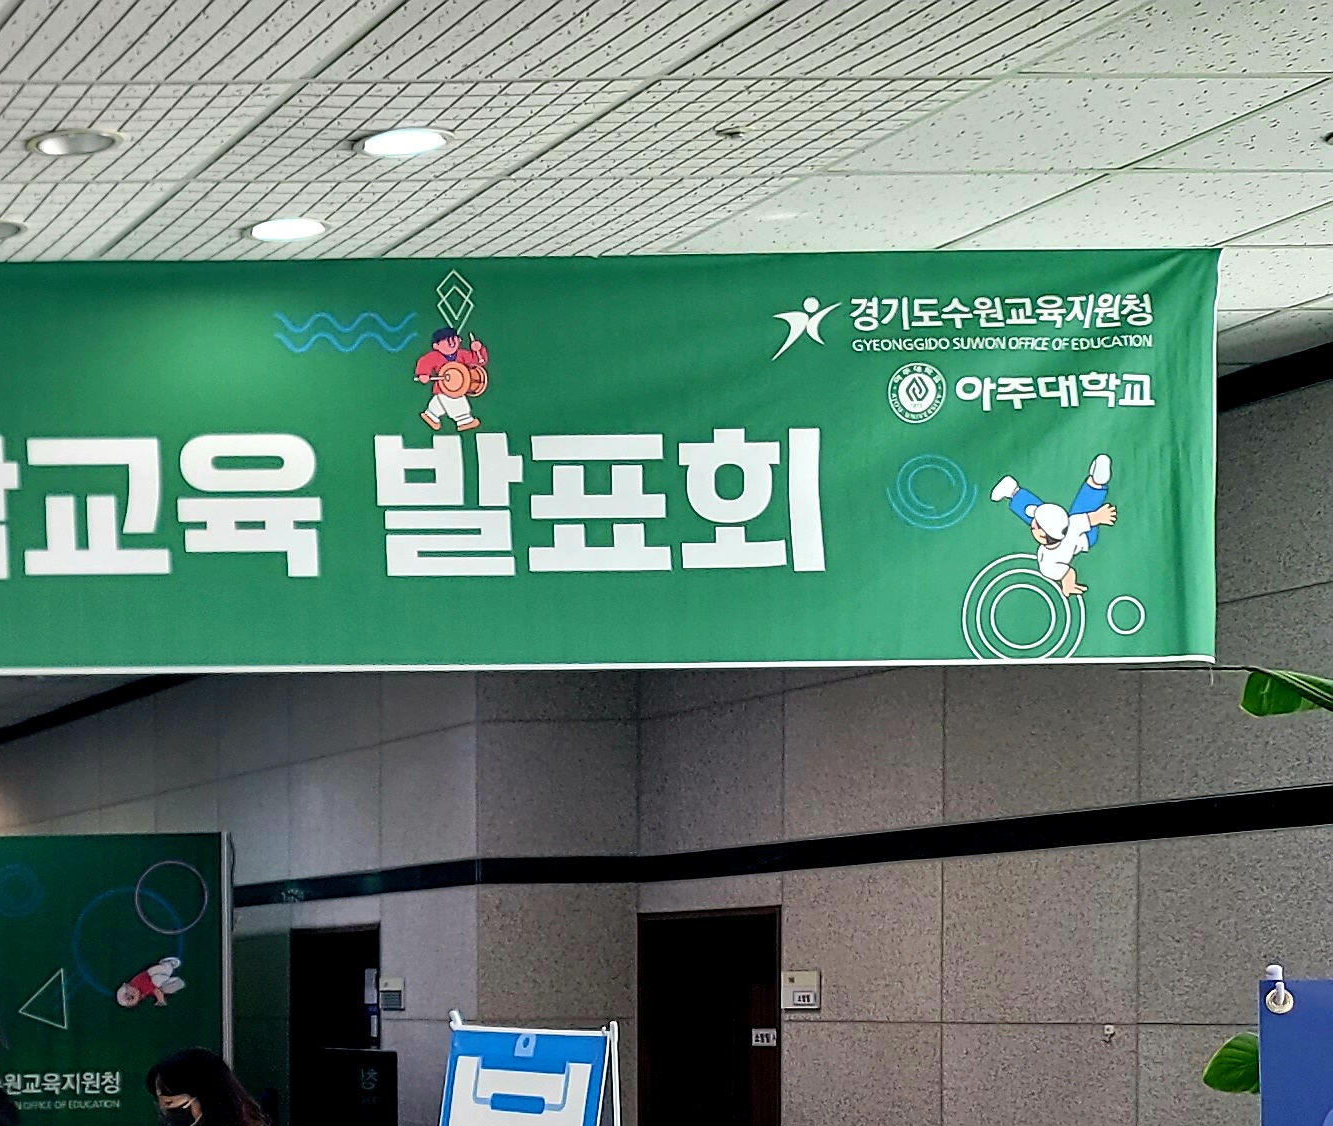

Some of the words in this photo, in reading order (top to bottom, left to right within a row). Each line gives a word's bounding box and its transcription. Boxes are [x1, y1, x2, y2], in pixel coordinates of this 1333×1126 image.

[850, 293, 1153, 332] 경기도수원교육지원청
[852, 337, 950, 352] GYEONGGIDO
[952, 336, 1006, 351] SUWON
[1008, 336, 1050, 351] OFFICE
[1051, 337, 1069, 351] OF
[1070, 334, 1153, 351] EDUCATION
[955, 371, 1156, 412] 아주대학교
[374, 428, 826, 577] 발표회
